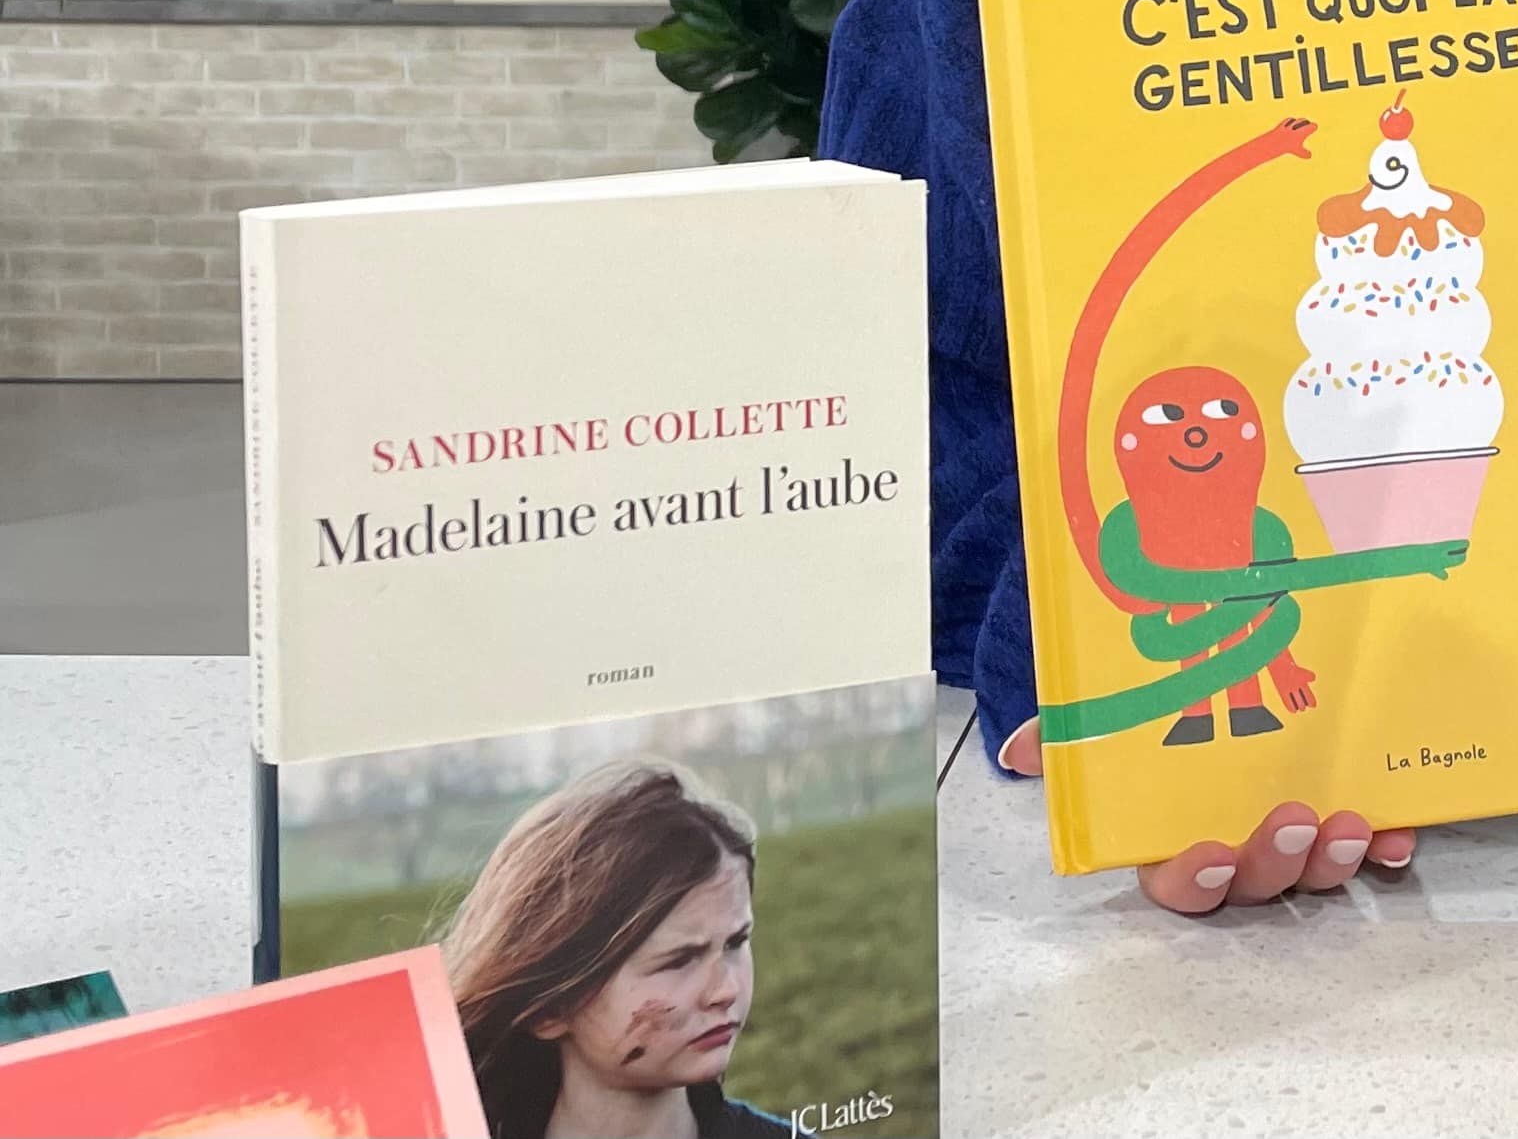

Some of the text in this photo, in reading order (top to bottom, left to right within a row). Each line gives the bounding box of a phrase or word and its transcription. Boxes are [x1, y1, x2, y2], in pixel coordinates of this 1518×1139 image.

[371, 394, 850, 474] SANDRINE COLLETTE
[314, 496, 597, 569] Madelaine
[613, 476, 745, 534] avant
[586, 663, 655, 687] roman
[1386, 743, 1487, 771] La Bagnole
[791, 1090, 893, 1139] JC Lattès
